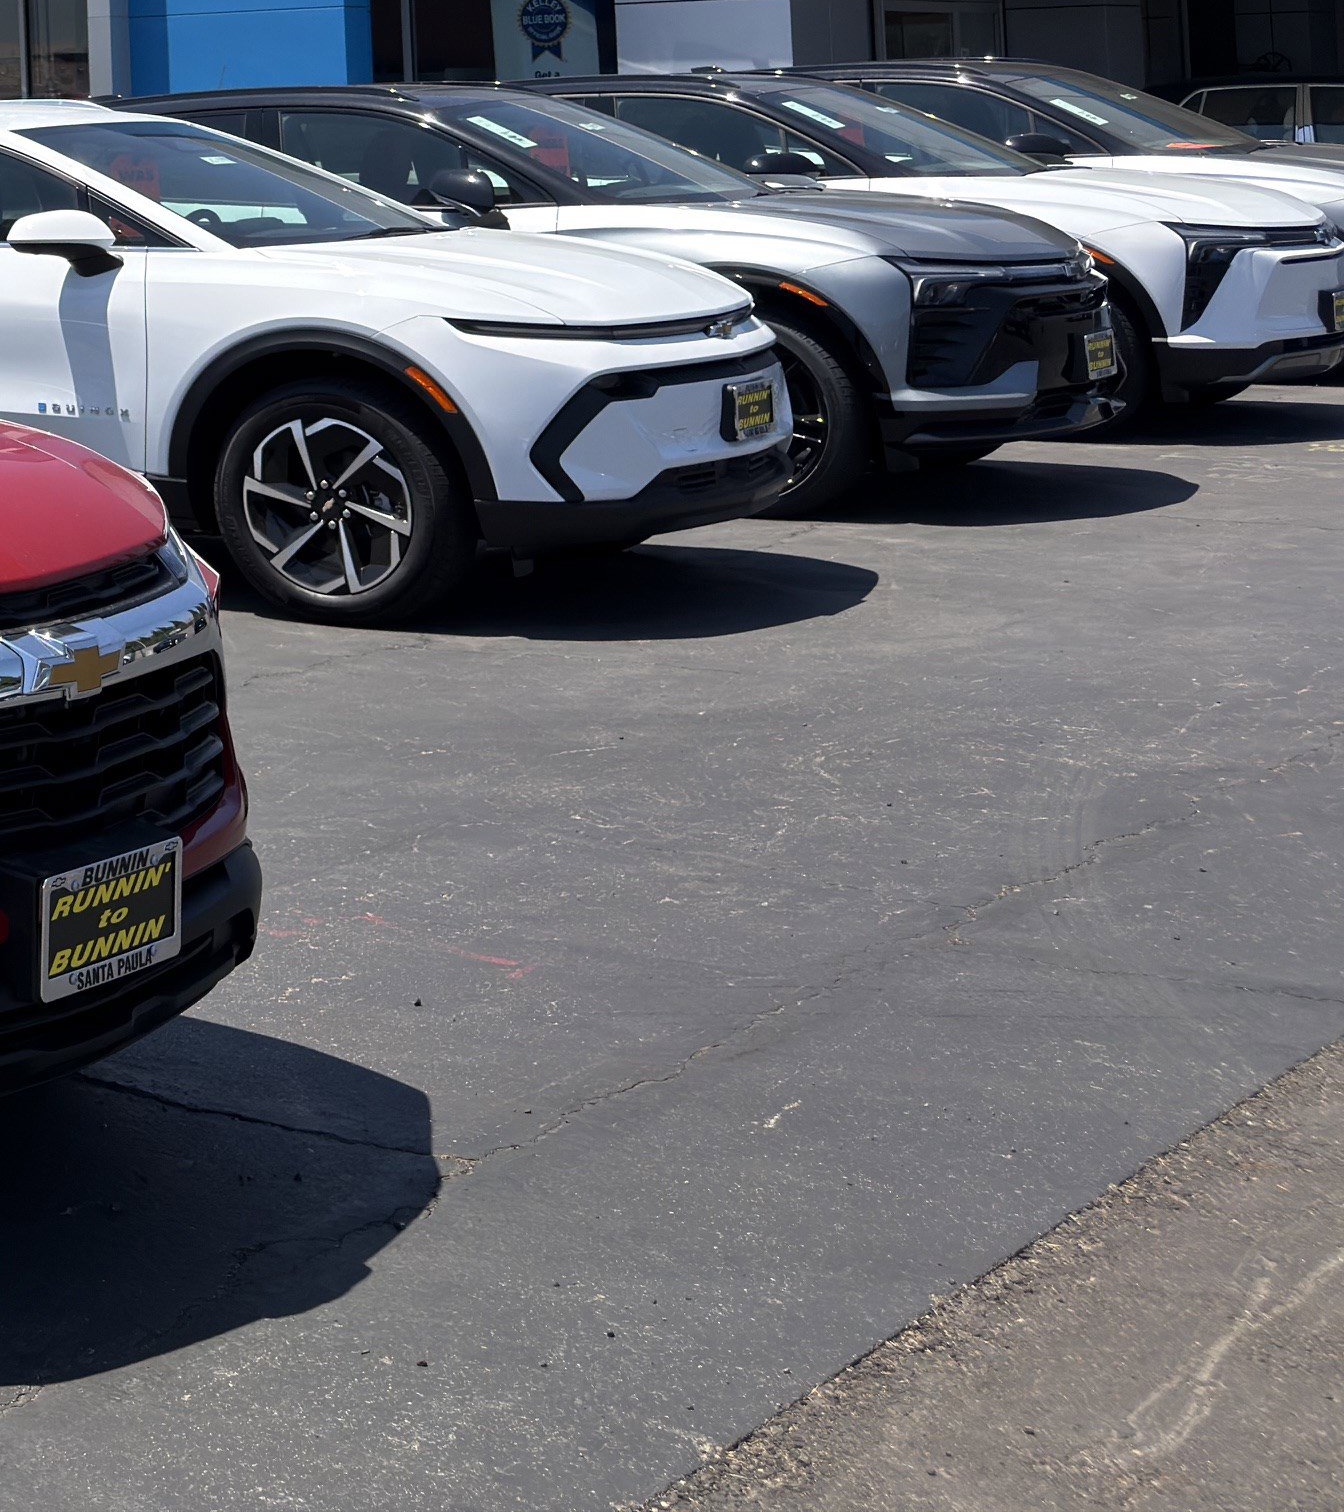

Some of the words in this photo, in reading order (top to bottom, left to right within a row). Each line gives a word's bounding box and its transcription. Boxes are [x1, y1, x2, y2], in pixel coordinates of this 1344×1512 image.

[522, 14, 543, 25] BLUE
[544, 14, 566, 24] BOOK
[81, 848, 150, 888] BUNNIN
[50, 861, 172, 922] RUNNIN'
[98, 906, 129, 929] to
[48, 914, 166, 977] BUNNIN
[76, 961, 113, 991] SANTA
[117, 948, 153, 976] PAULA
